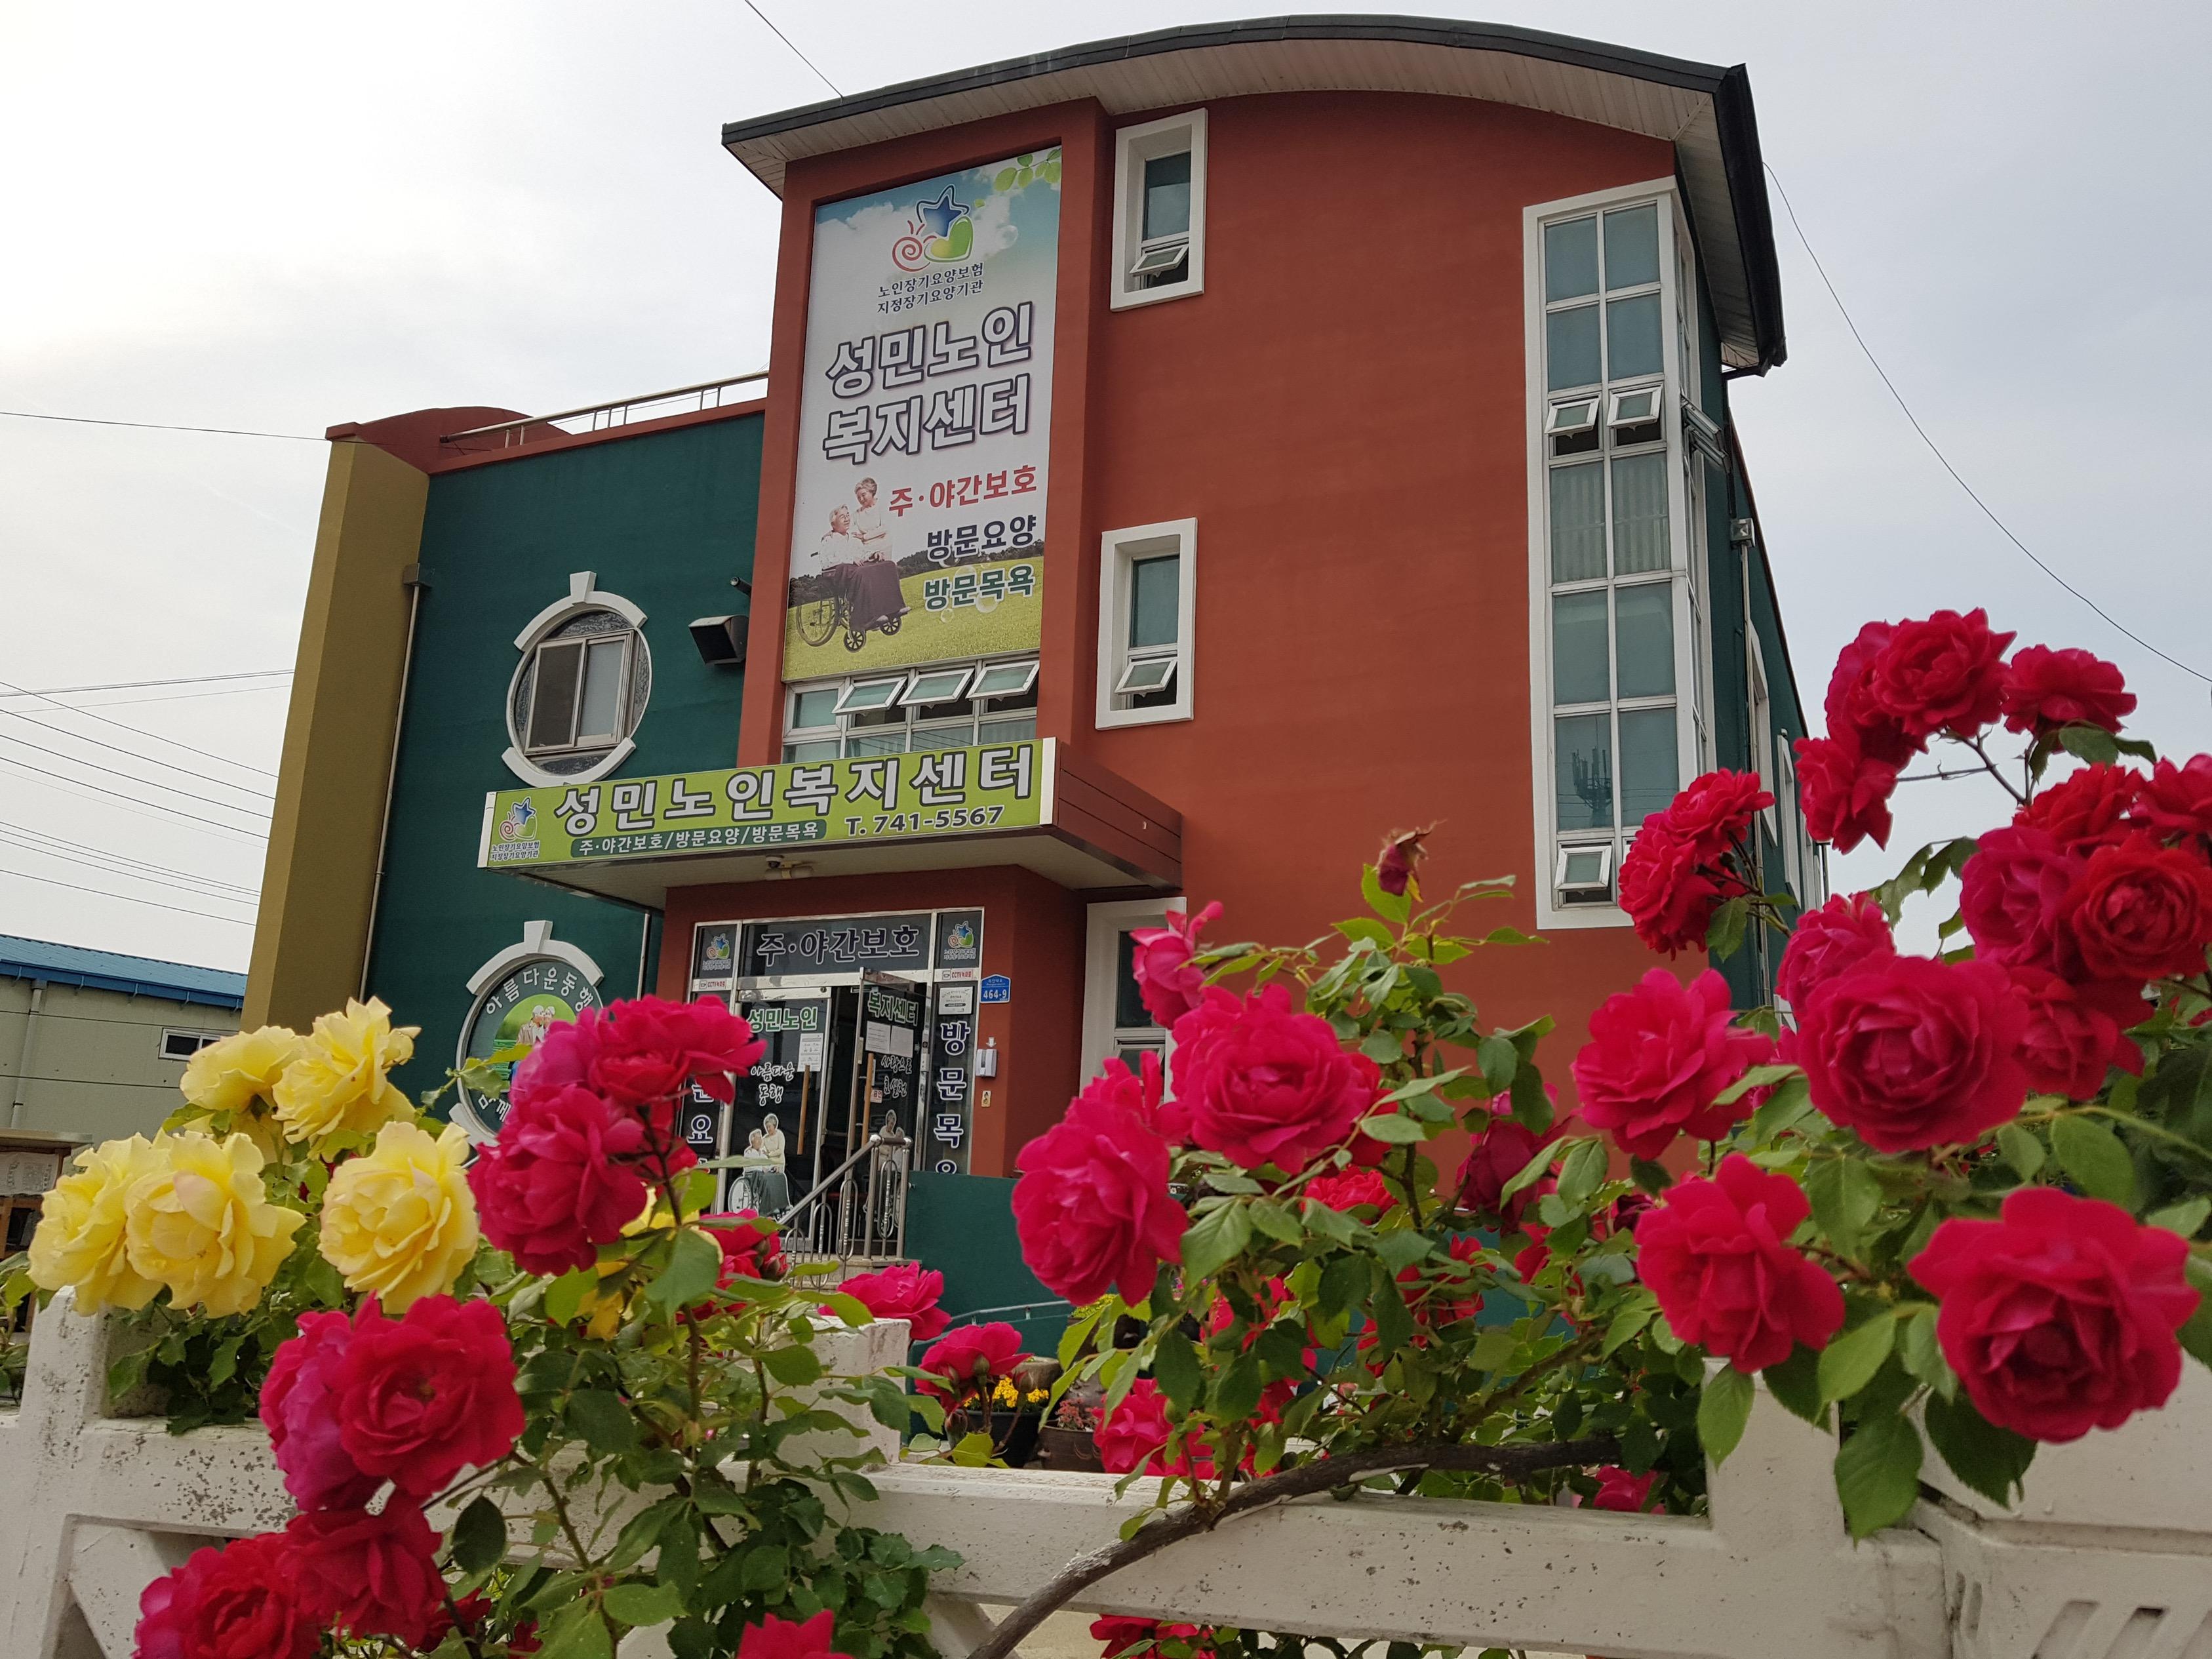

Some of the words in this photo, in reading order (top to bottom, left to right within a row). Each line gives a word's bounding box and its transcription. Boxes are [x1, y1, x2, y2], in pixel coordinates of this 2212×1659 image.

[877, 280, 983, 314] 지정장기요양기관
[878, 262, 984, 298] 노인장기요양보험
[825, 301, 1033, 399] 성민노인
[822, 372, 1031, 466] 복지센터
[927, 514, 1037, 561] 방문요양
[924, 564, 1036, 612] 방문목욕
[554, 744, 1033, 836] 성민노인복지센터
[845, 817, 867, 837] T.
[873, 805, 1005, 835] 741-5567
[867, 990, 918, 1026] 복지센터
[983, 989, 1007, 999] 464-9
[746, 1007, 818, 1033] 성민노인
[751, 1062, 795, 1082] 아름다운
[759, 1083, 784, 1106] 동행
